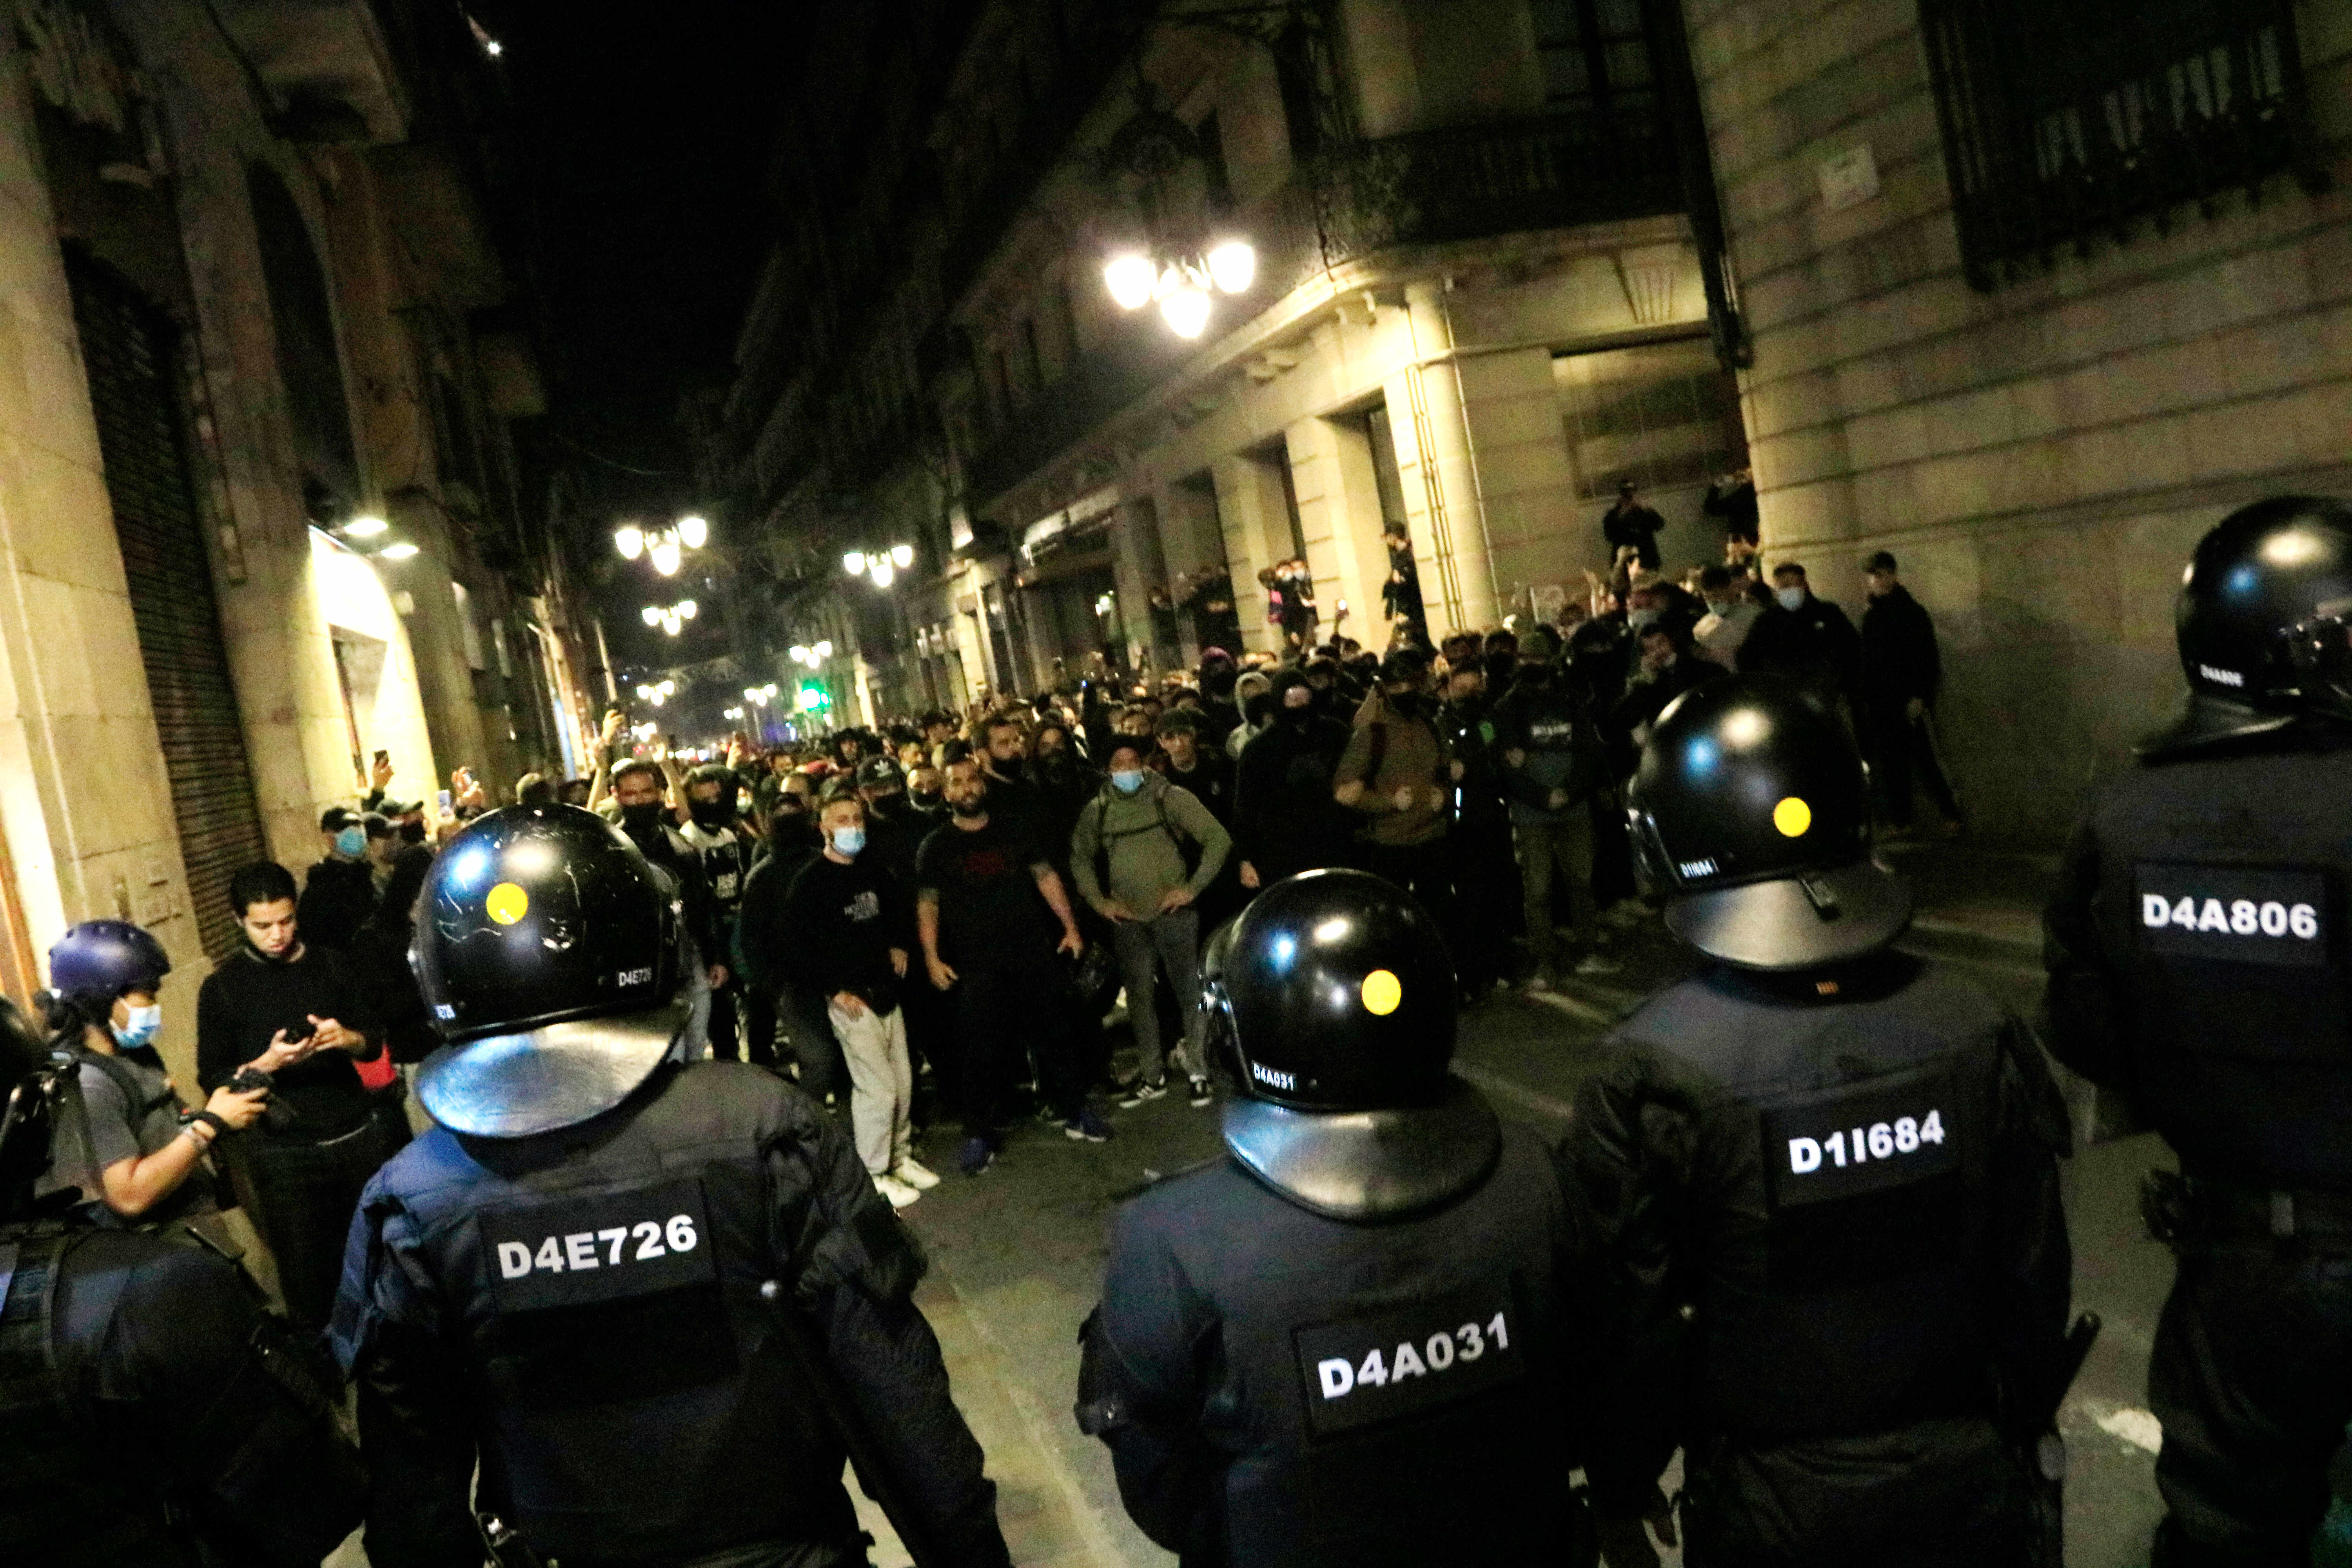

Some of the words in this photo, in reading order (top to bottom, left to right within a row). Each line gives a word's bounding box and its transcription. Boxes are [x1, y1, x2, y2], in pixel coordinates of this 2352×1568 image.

[2143, 894, 2318, 939] D4A806
[1254, 1063, 1294, 1091] D4A031
[497, 1214, 697, 1279] D4E726
[1318, 1312, 1508, 1399] D4A031
